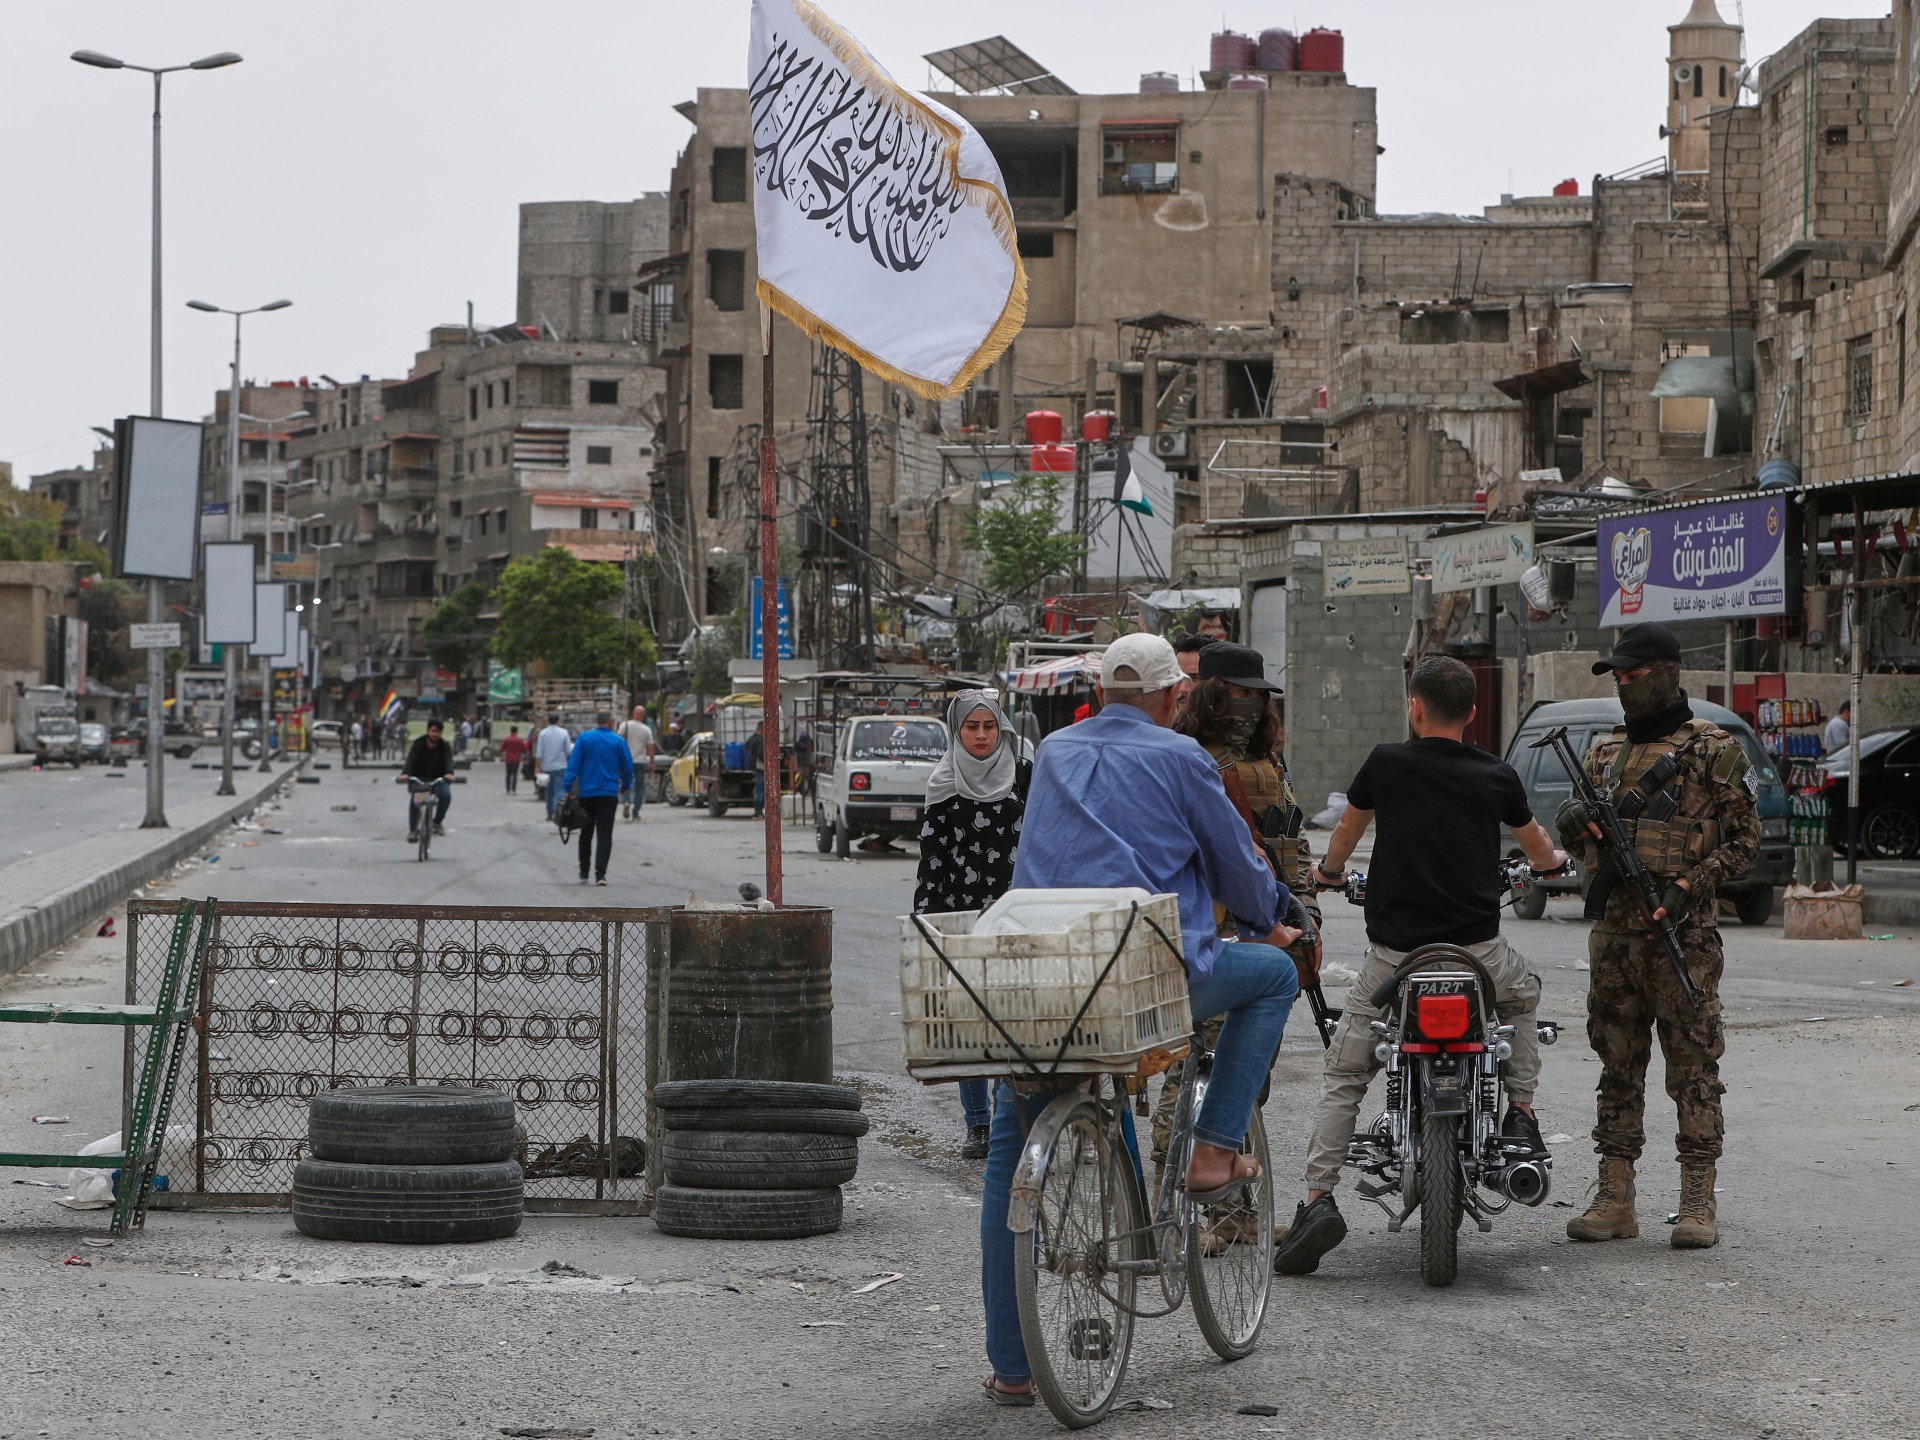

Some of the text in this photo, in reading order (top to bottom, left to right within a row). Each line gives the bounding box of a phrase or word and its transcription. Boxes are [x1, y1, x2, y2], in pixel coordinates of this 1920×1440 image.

[1673, 520, 1702, 540] عمار
[1769, 516, 1777, 528] 24
[1673, 536, 1744, 587] المنفوش
[1692, 596, 1706, 612] مواد
[1416, 981, 1464, 997] PART
